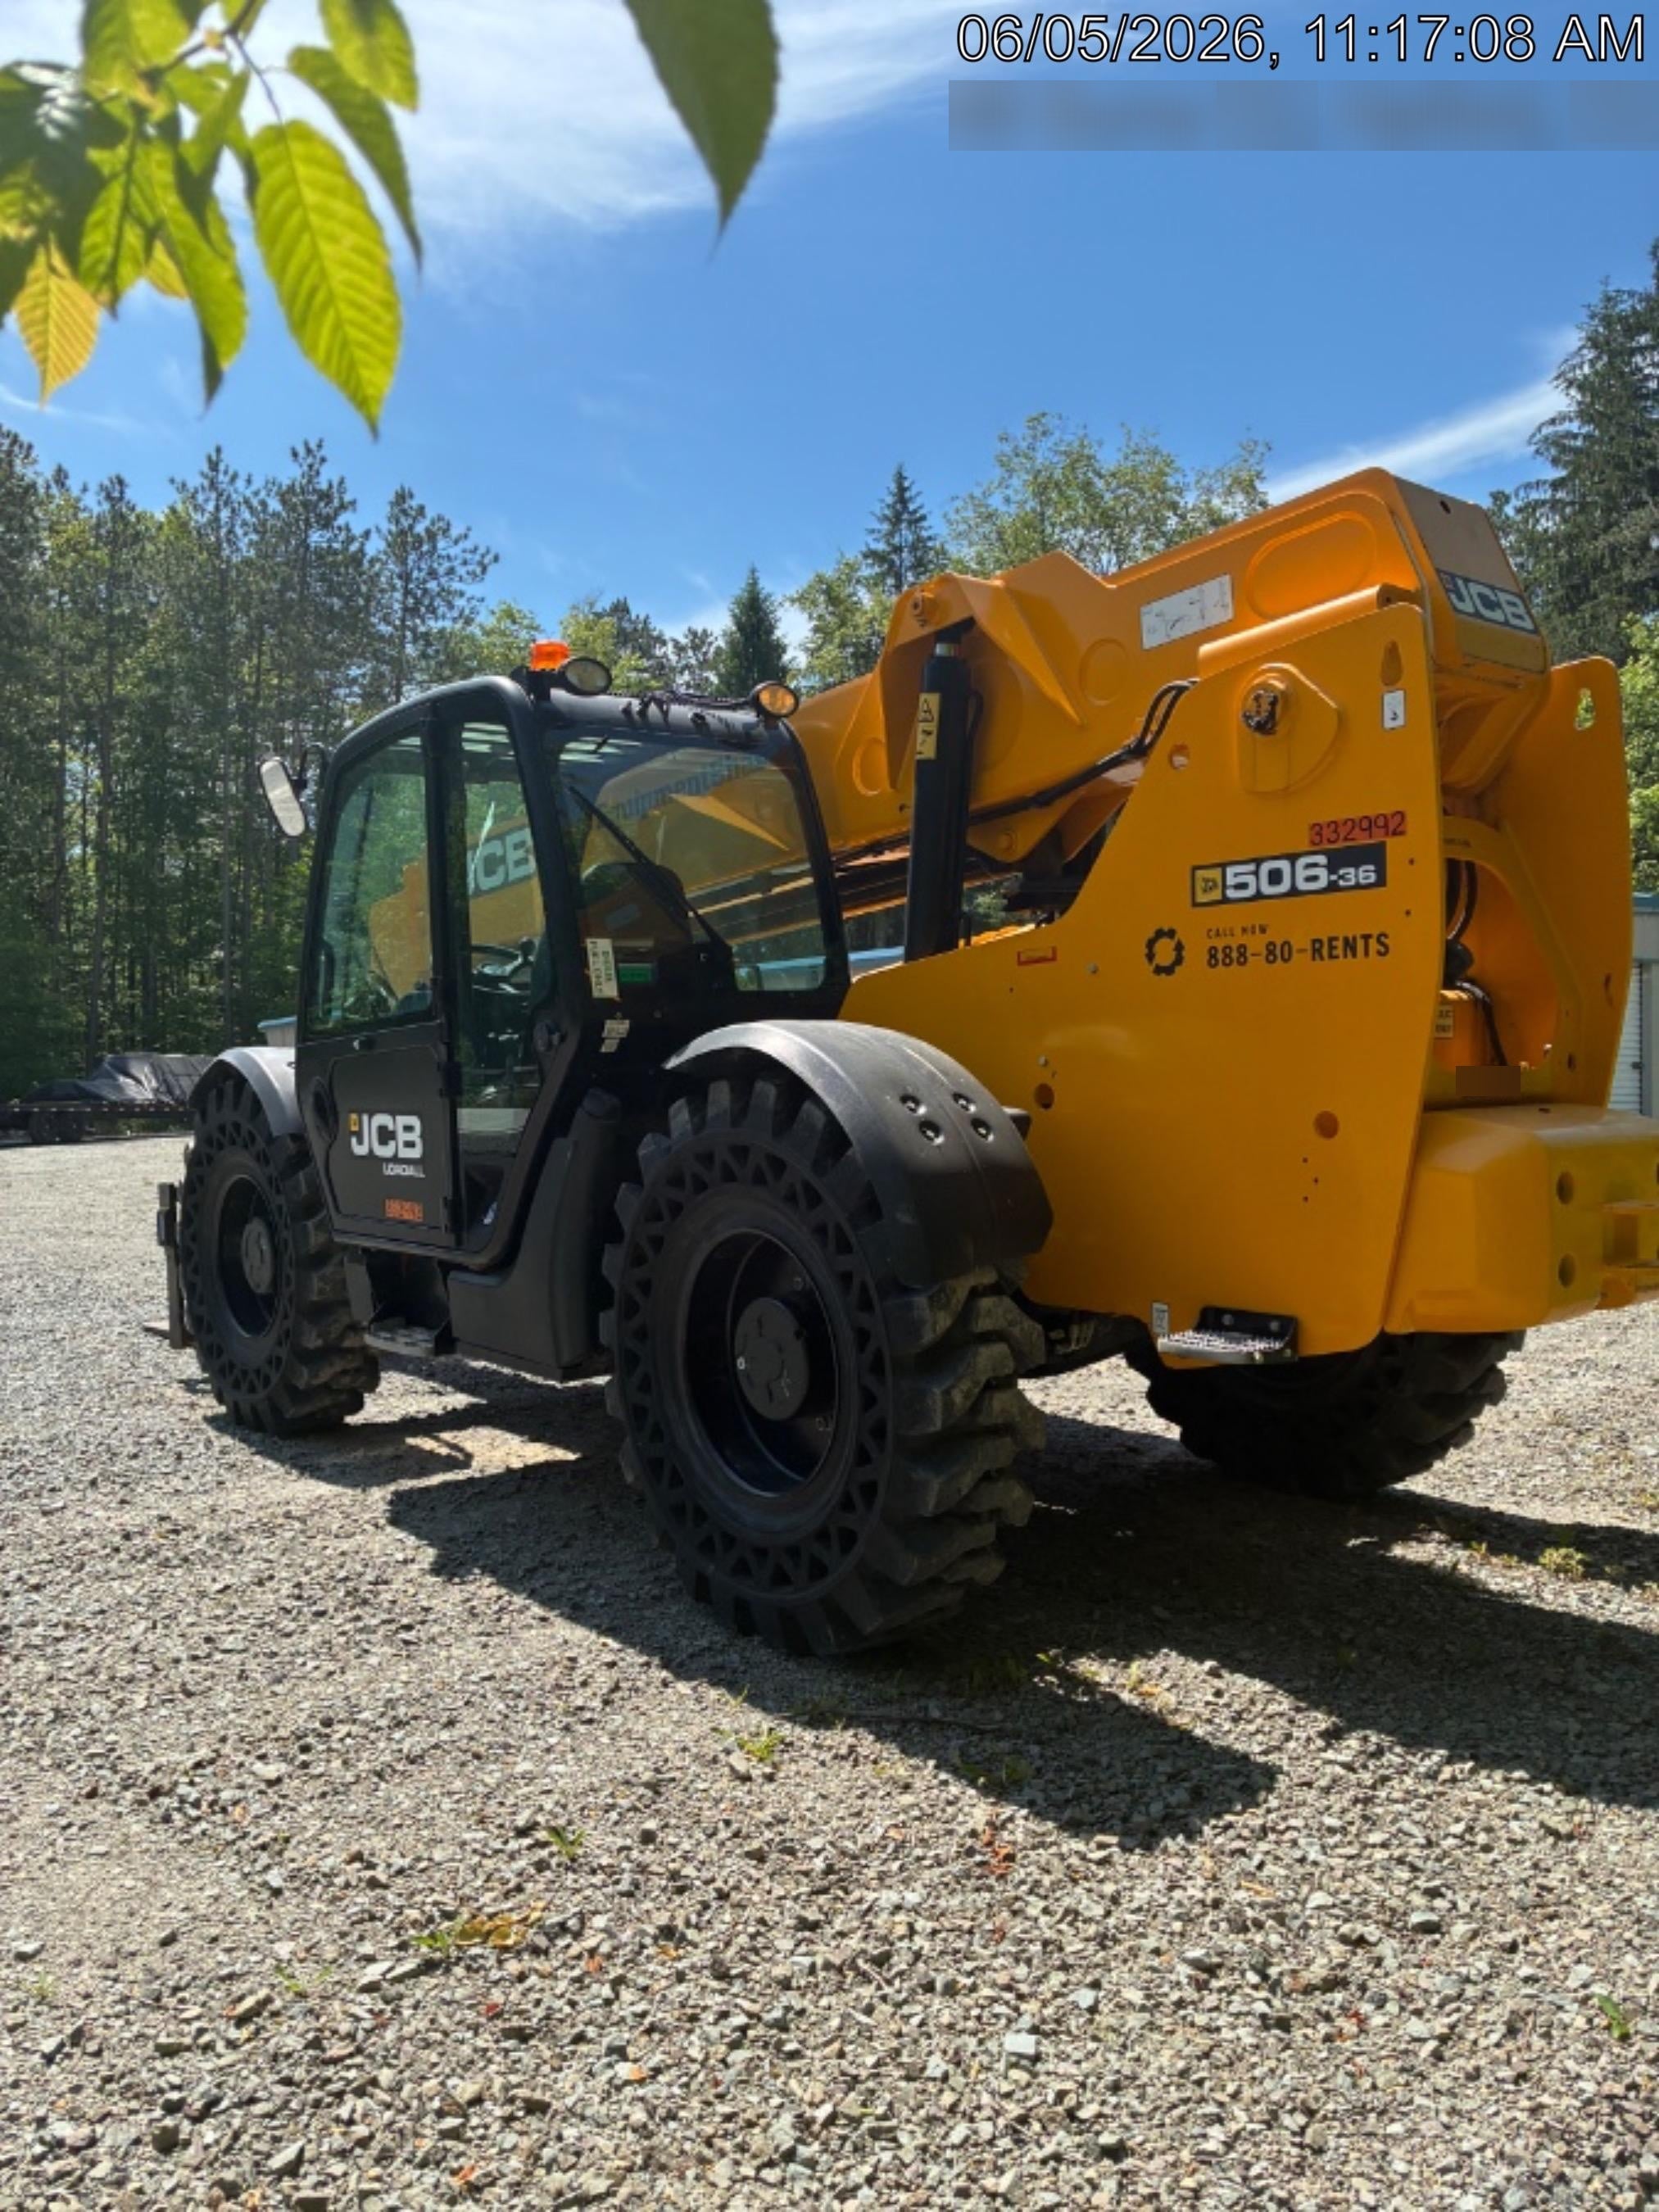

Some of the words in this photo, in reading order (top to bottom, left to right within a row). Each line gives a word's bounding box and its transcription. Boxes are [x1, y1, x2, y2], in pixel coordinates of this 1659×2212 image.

[1448, 577, 1535, 630] JCB
[1310, 810, 1406, 845] 332992
[1207, 927, 1235, 939] CALL
[1241, 923, 1269, 935] NOW
[1207, 933, 1391, 969] 888-80-RENTS
[350, 1113, 424, 1158] JCB
